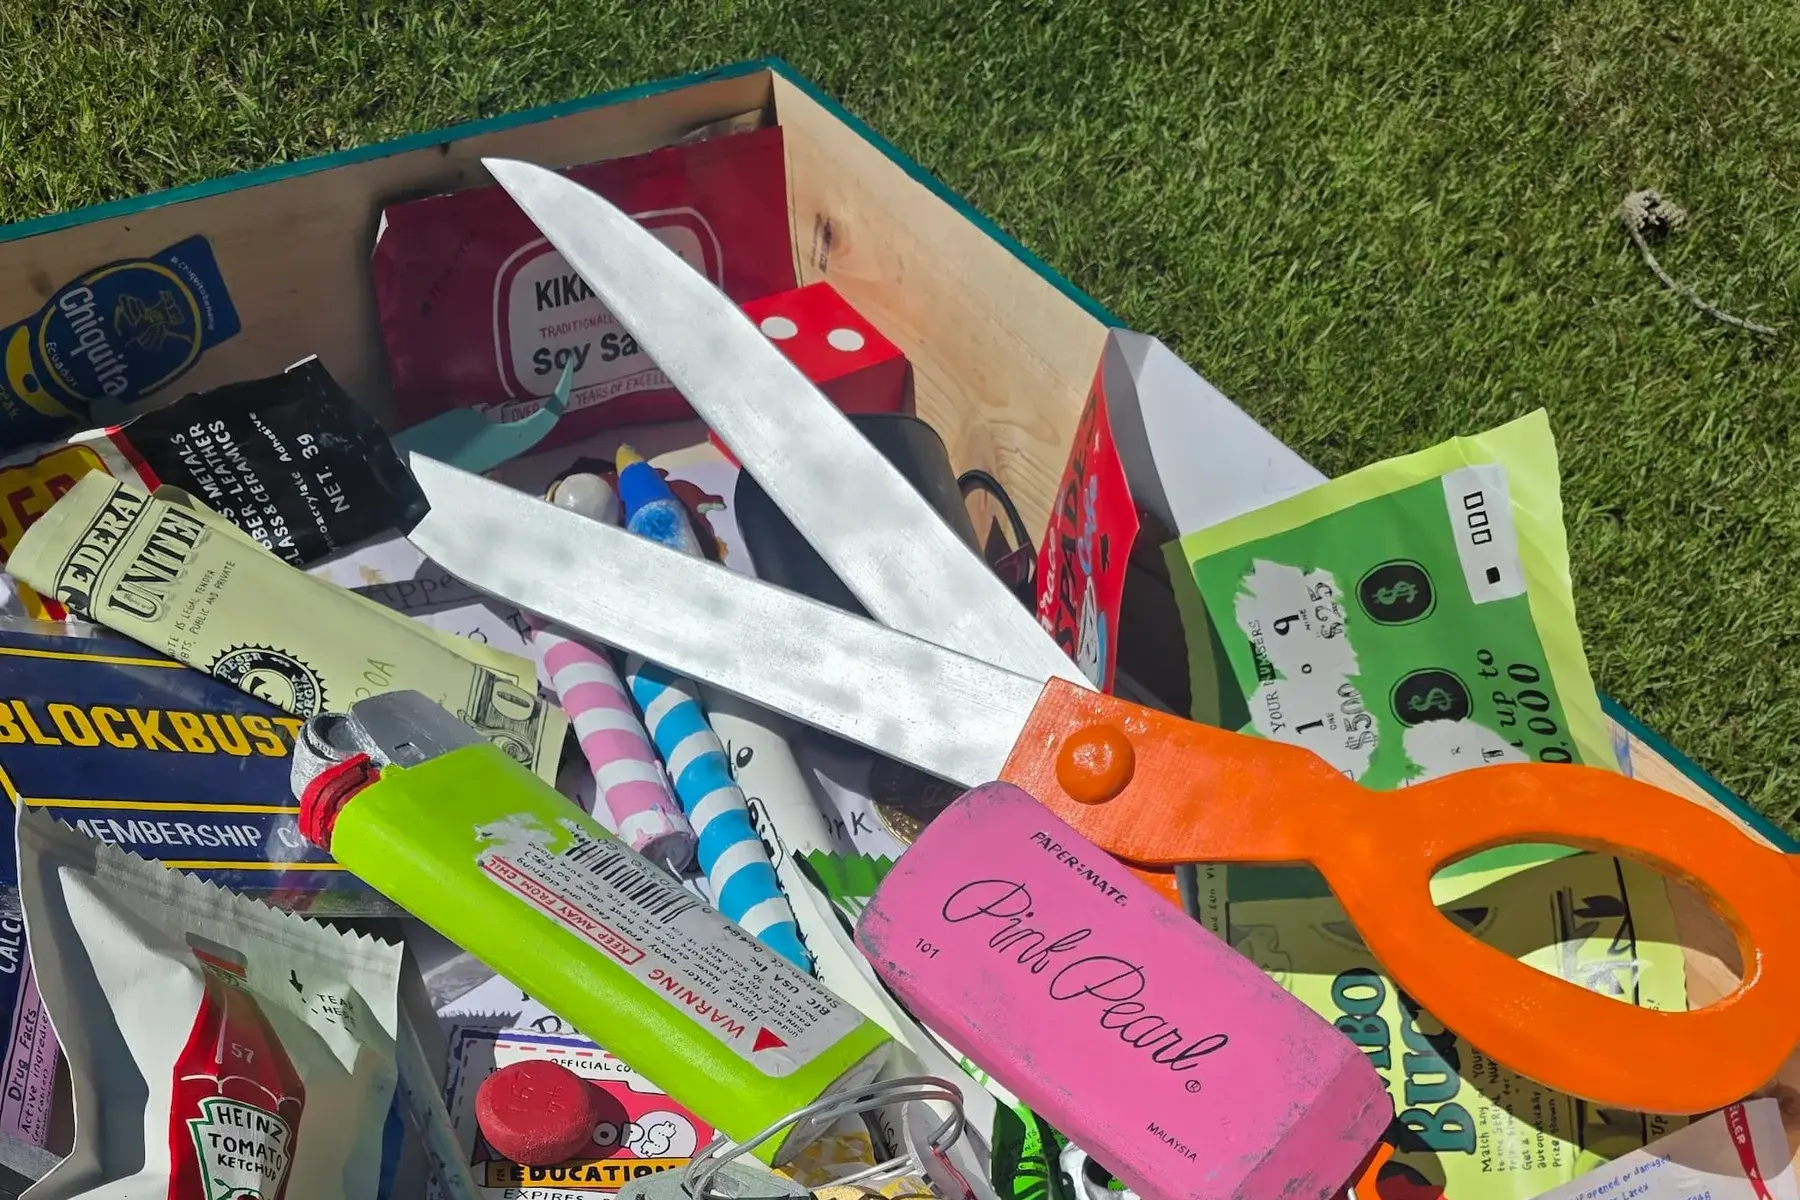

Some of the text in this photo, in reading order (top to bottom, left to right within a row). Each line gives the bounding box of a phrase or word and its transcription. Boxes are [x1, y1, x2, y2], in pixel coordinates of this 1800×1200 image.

[535, 273, 597, 311] KIKK
[59, 287, 128, 397] Chiquita
[532, 343, 591, 375] Soy
[45, 341, 79, 389] Ecuador
[575, 381, 625, 406] YEARS OF
[249, 412, 293, 464] Adhesive
[171, 433, 223, 499] METALS
[189, 423, 243, 495] LEATHER
[208, 420, 270, 503] CERAMICS
[316, 465, 350, 514] NET.
[264, 504, 278, 515] &
[176, 569, 216, 631] IS LEGAL TENDER
[189, 560, 236, 635] PUBLIC AND PRIVATE
[1299, 608, 1311, 631] NINE
[1476, 648, 1518, 728] up to
[0, 700, 304, 757] BLOCKBUST
[1265, 690, 1286, 734] YOUR
[1295, 718, 1324, 735] 1
[1326, 712, 1338, 731] ONE
[76, 819, 262, 848] MEMBERSHIP
[515, 855, 560, 889] clothing
[519, 877, 556, 907] FROM
[556, 902, 596, 933] AWAY
[584, 901, 610, 921] face
[942, 879, 1092, 974] Pink
[596, 929, 630, 956] KEEP
[614, 921, 643, 943] from
[915, 937, 940, 960] 101
[647, 940, 678, 966] away
[680, 964, 720, 996] lighter
[773, 973, 830, 1016] BIC USA
[646, 964, 745, 1040] WARNING
[723, 993, 759, 1023] Ignite
[1049, 955, 1229, 1072] Pearl
[8, 1008, 37, 1101] Drug Facts
[231, 1043, 254, 1062] 57
[21, 1085, 37, 1134] Active
[217, 1107, 285, 1143] HEINZ
[208, 1133, 284, 1169] TOMATO
[591, 1120, 677, 1157] OPS
[1147, 1121, 1198, 1164] MALAYSIA
[1479, 1106, 1492, 1172] Match any
[217, 1154, 277, 1181] KETCHUP
[1522, 1150, 1532, 1171] Get
[1585, 1177, 1621, 1200] opened
